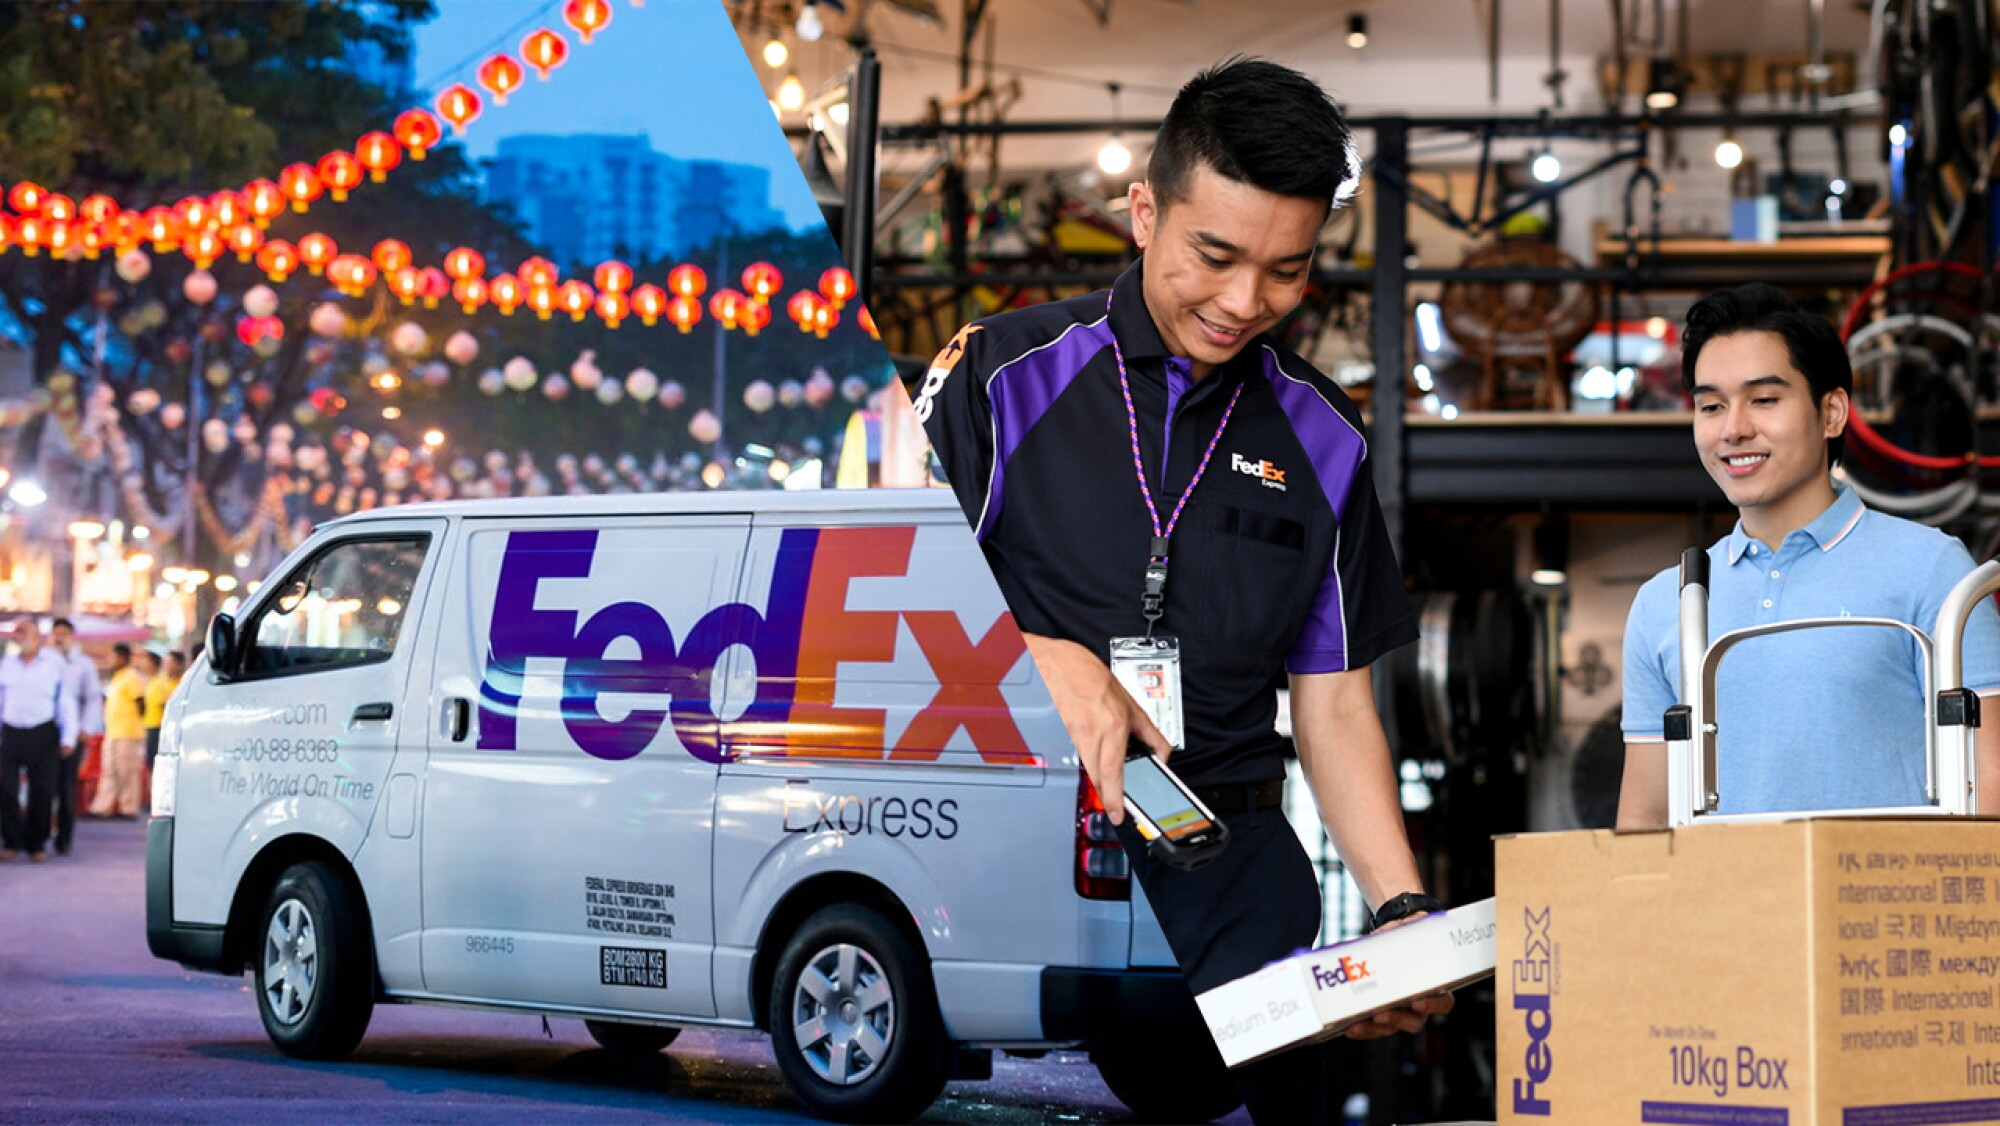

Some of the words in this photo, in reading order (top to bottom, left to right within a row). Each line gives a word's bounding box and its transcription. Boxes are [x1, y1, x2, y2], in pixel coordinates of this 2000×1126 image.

[1231, 452, 1286, 483] FedEx
[476, 525, 1036, 764] FedEx
[219, 738, 339, 762] -800-88-6363
[218, 770, 247, 794] The
[249, 772, 298, 797] World
[303, 773, 328, 797] On
[332, 774, 375, 800] Time
[783, 779, 960, 847] Express
[1886, 912, 1926, 938] 국제
[464, 934, 515, 954] 966445
[648, 951, 664, 969] KG
[1311, 955, 1371, 991] FedEx
[648, 969, 664, 987] KG
[1266, 998, 1301, 1022] Box
[1512, 905, 1551, 1116] FedEx
[1892, 985, 1993, 1011] Internacional
[1925, 1020, 1966, 1046] 국제
[1669, 1045, 1728, 1098] 10kg
[1736, 1045, 1789, 1091] Box
